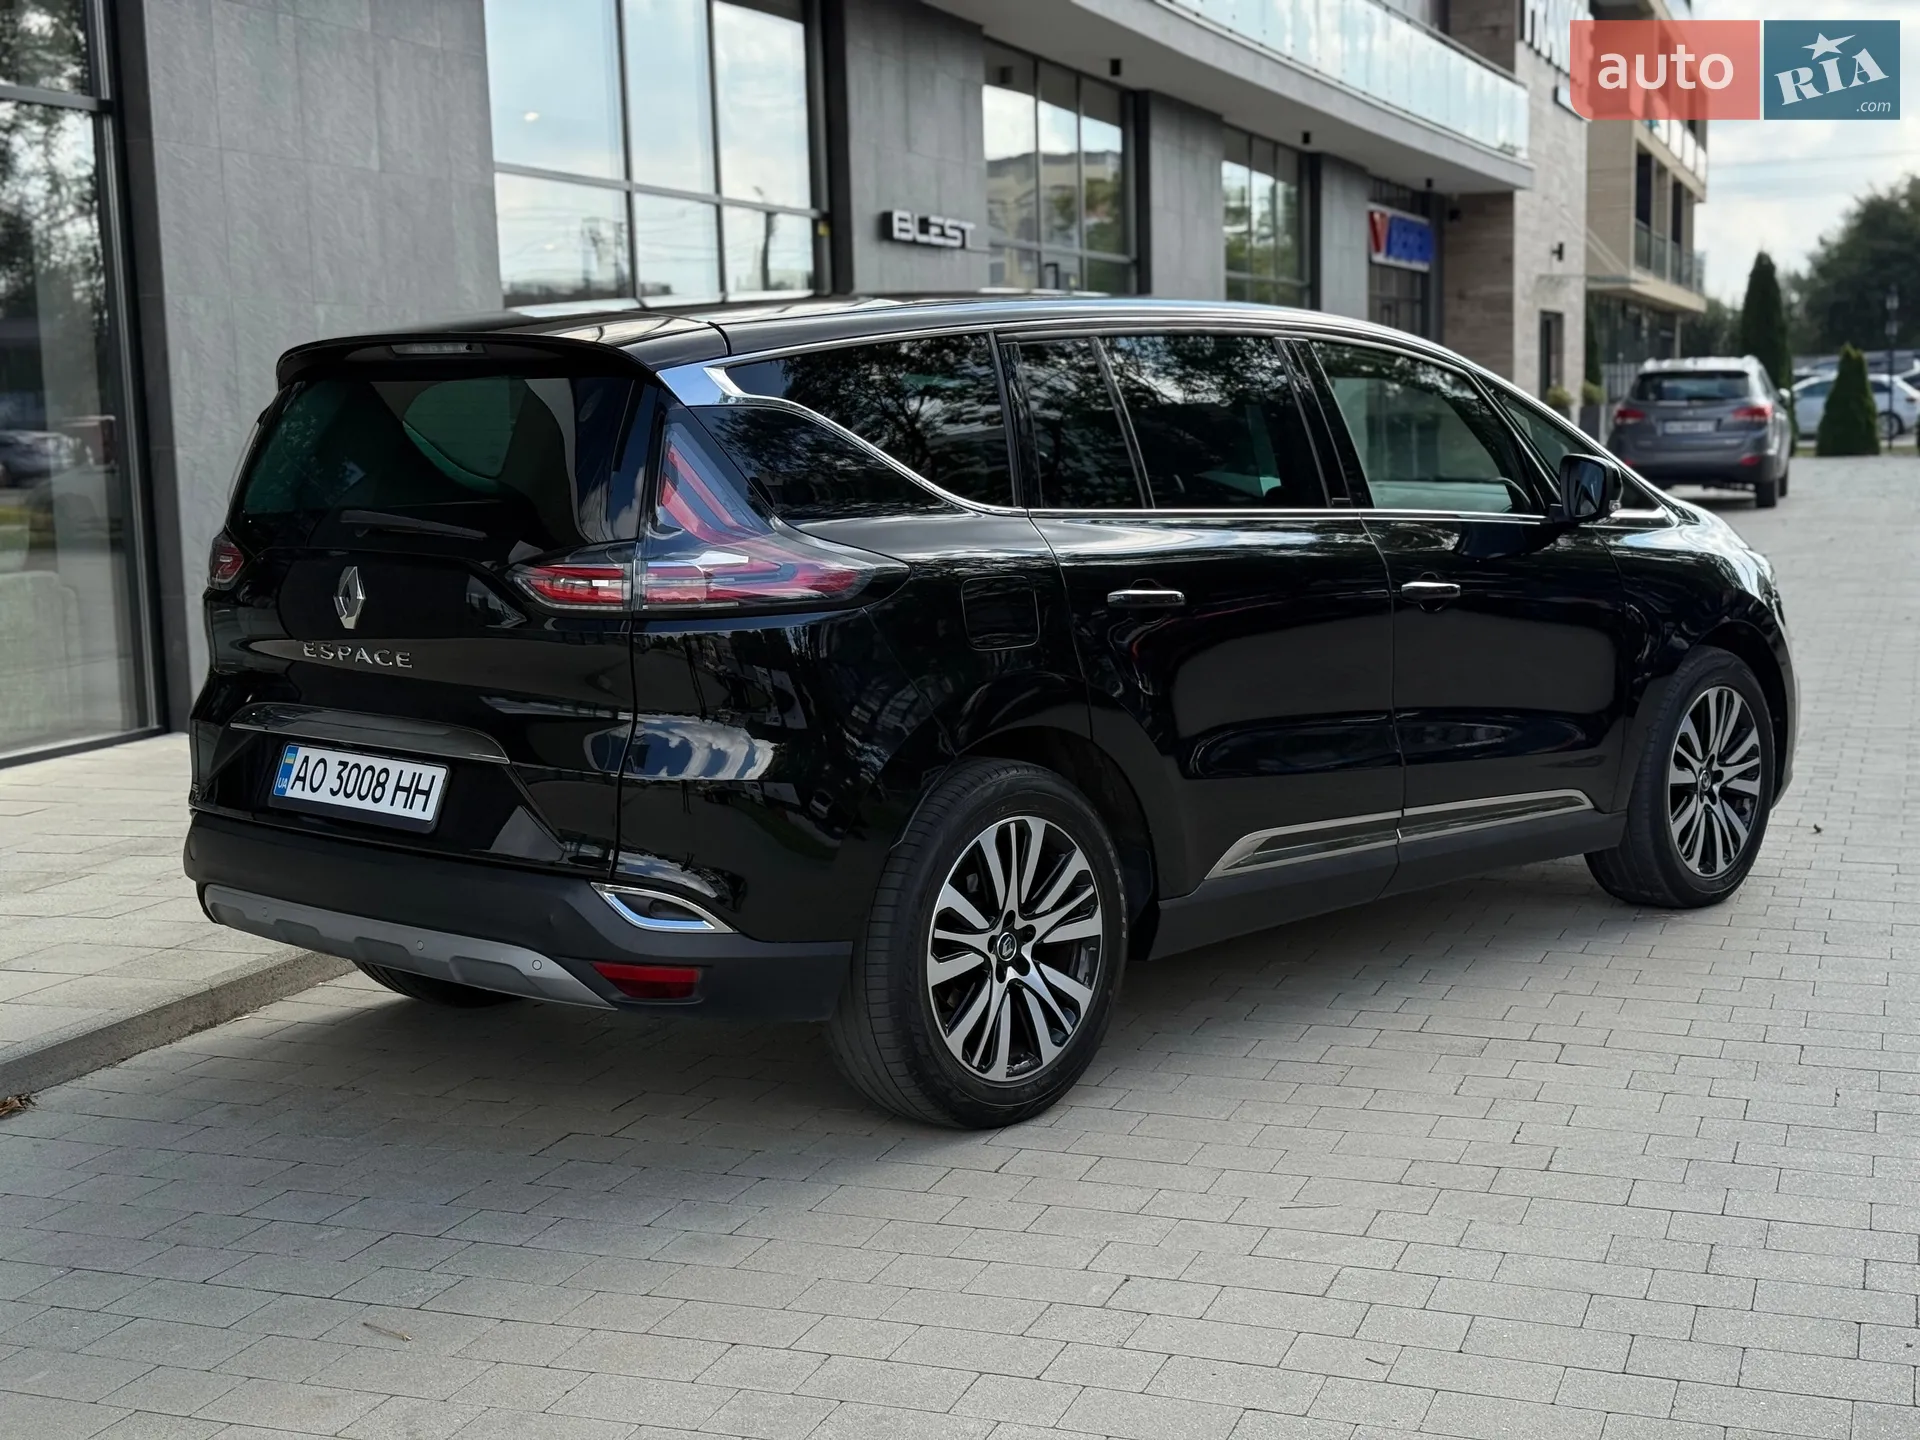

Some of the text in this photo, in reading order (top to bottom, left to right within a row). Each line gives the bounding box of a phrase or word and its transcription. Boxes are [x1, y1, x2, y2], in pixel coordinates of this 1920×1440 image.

[893, 210, 976, 249] BLEST
[302, 642, 413, 669] ESPACE
[277, 776, 288, 789] UA
[290, 755, 436, 812] AO 3008 HH
